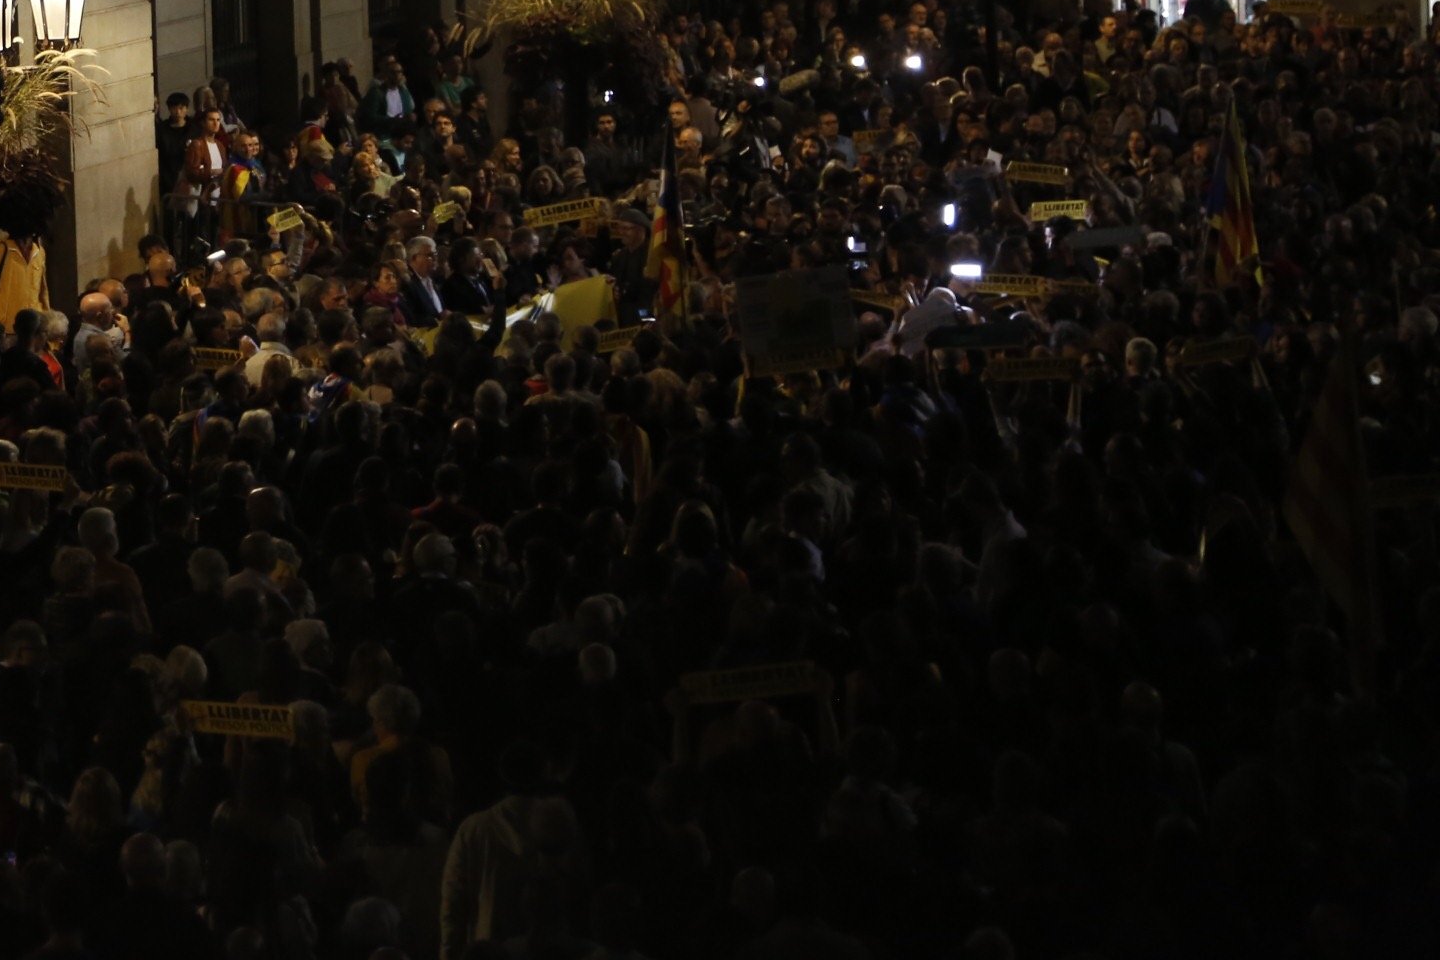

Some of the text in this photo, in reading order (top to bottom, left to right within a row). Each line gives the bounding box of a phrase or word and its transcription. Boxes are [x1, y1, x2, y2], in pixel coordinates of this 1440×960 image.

[540, 200, 595, 217] LLIBERTAT
[1044, 203, 1084, 212] LLIBERTAT
[207, 705, 289, 723] LLIBERTAT
